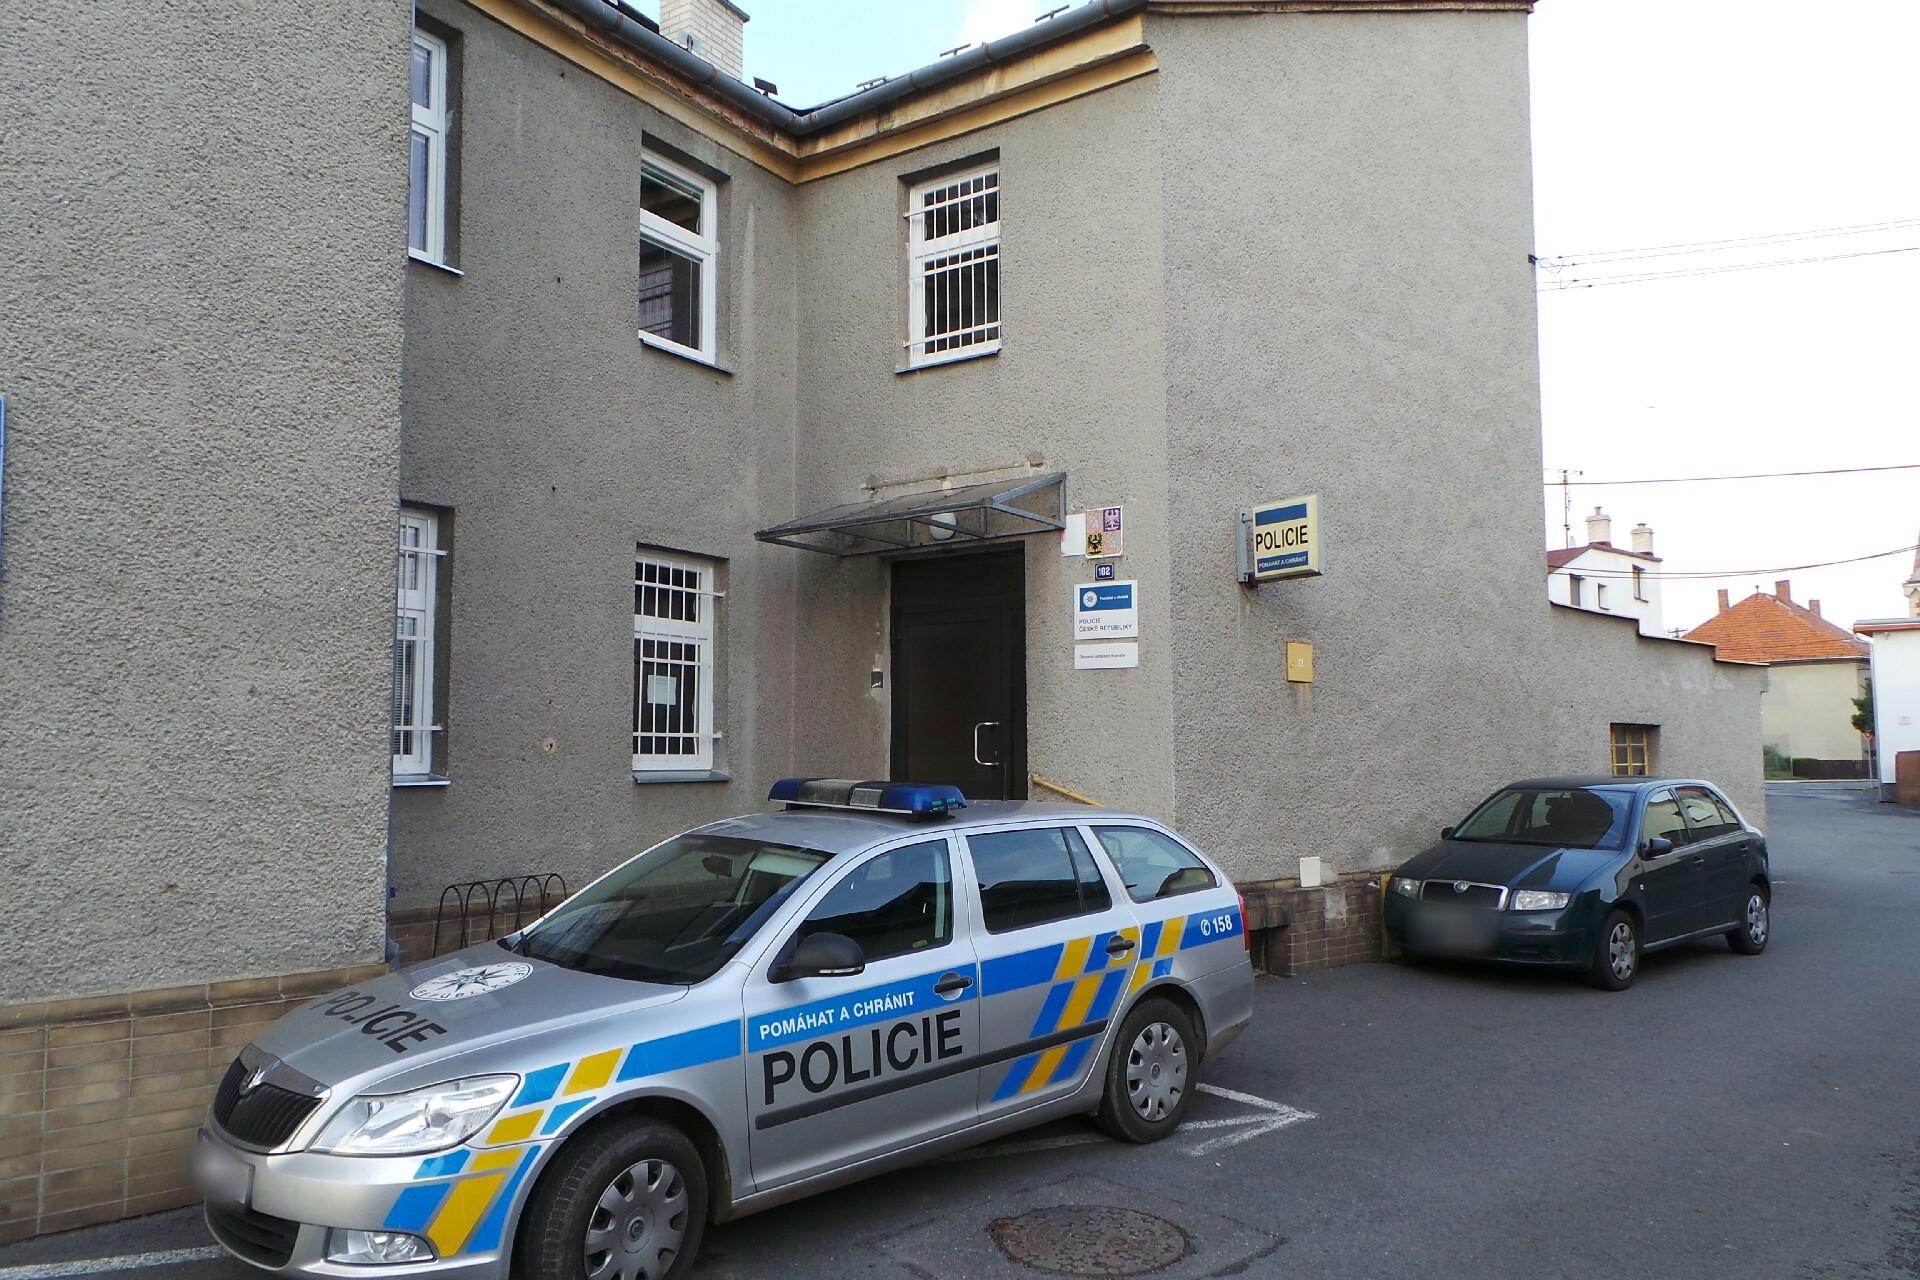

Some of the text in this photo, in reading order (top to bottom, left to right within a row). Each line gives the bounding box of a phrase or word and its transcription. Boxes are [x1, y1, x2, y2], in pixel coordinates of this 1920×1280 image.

[1255, 524, 1308, 552] POLICIE
[1098, 566, 1111, 577] 102
[1079, 617, 1101, 625] POLICIE
[1212, 914, 1233, 934] 158
[309, 991, 448, 1054] POLICIE
[759, 991, 915, 1040] POMÁHAT A CHRÁNIT
[762, 1009, 963, 1106] POLICIE
